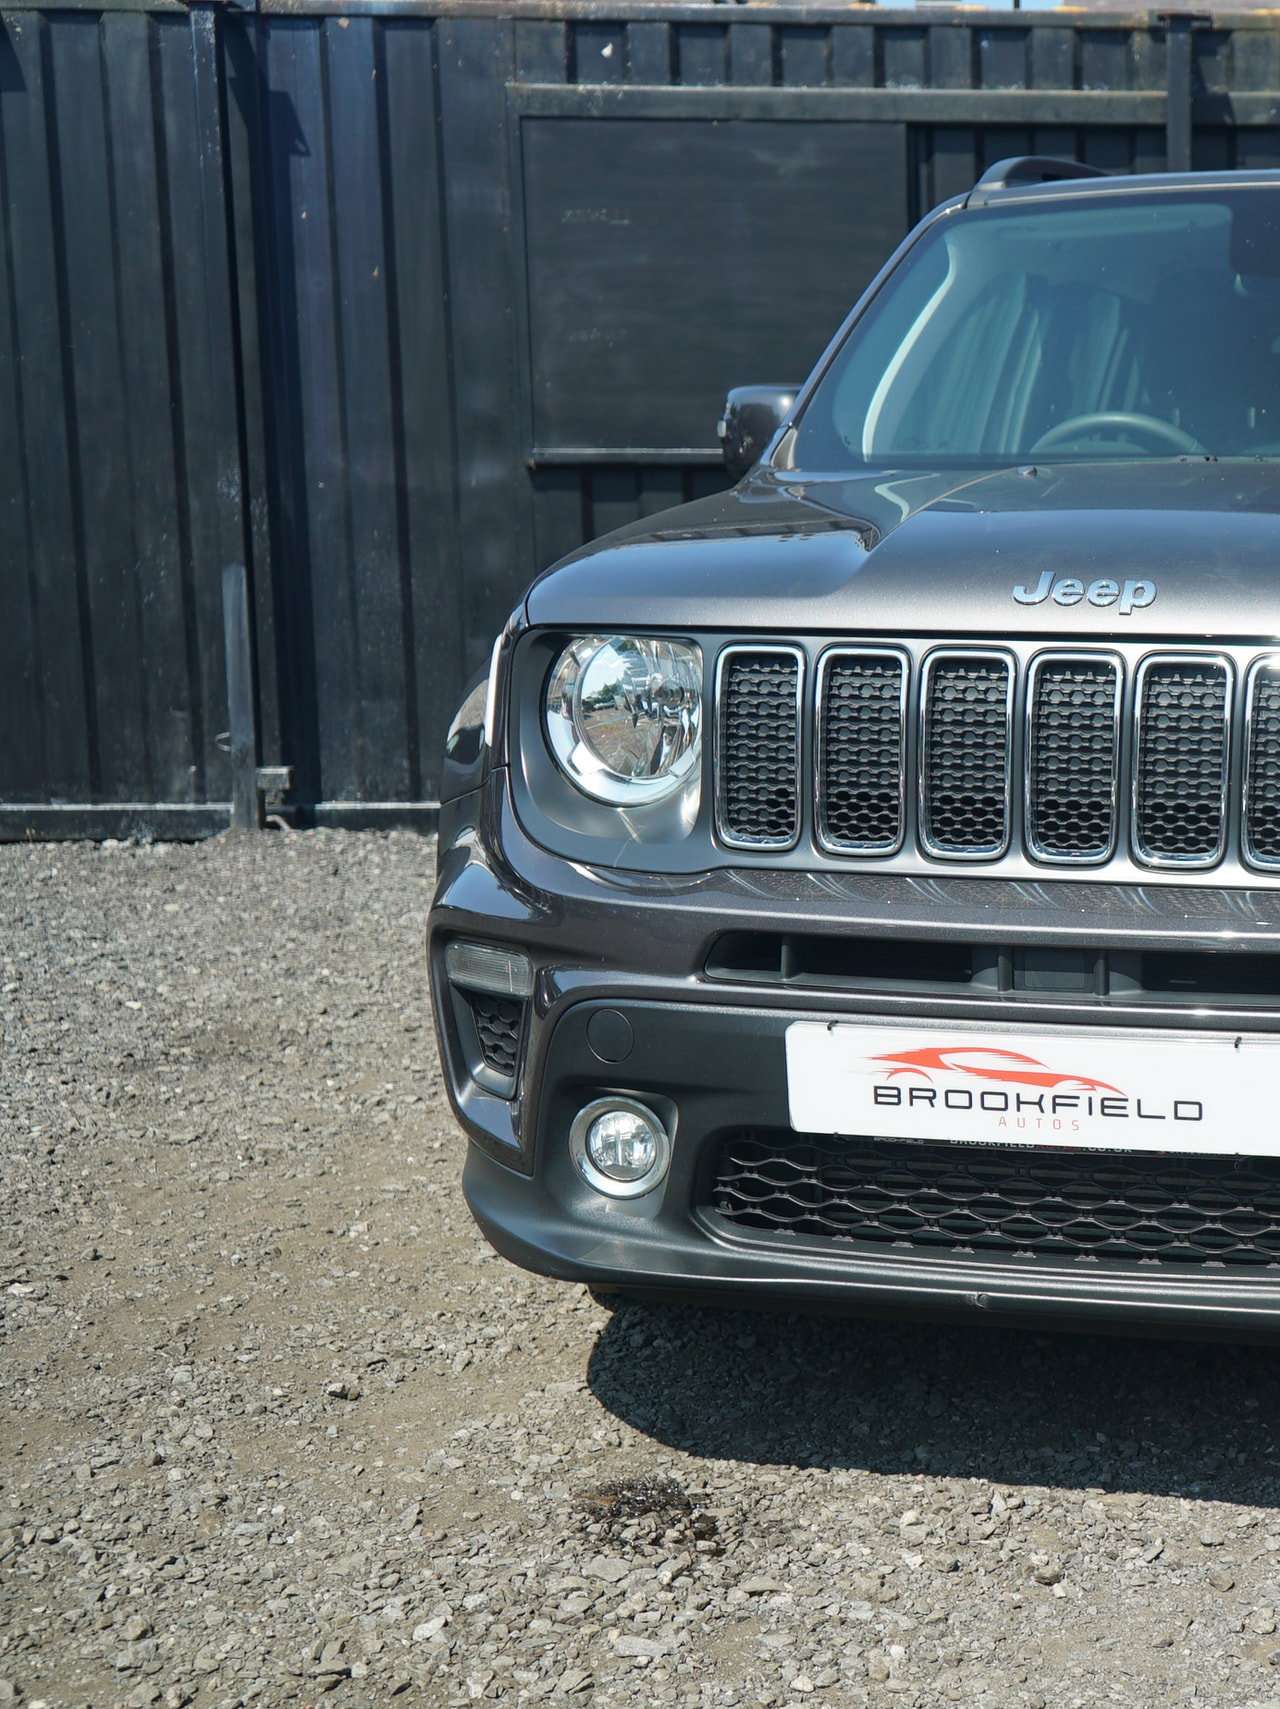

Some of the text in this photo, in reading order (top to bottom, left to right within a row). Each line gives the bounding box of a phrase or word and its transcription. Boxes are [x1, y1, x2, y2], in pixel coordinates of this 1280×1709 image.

[1012, 570, 1157, 616] Jeep
[873, 1085, 1203, 1121] BROOKFIELD
[998, 1116, 1080, 1131] AUTOS
